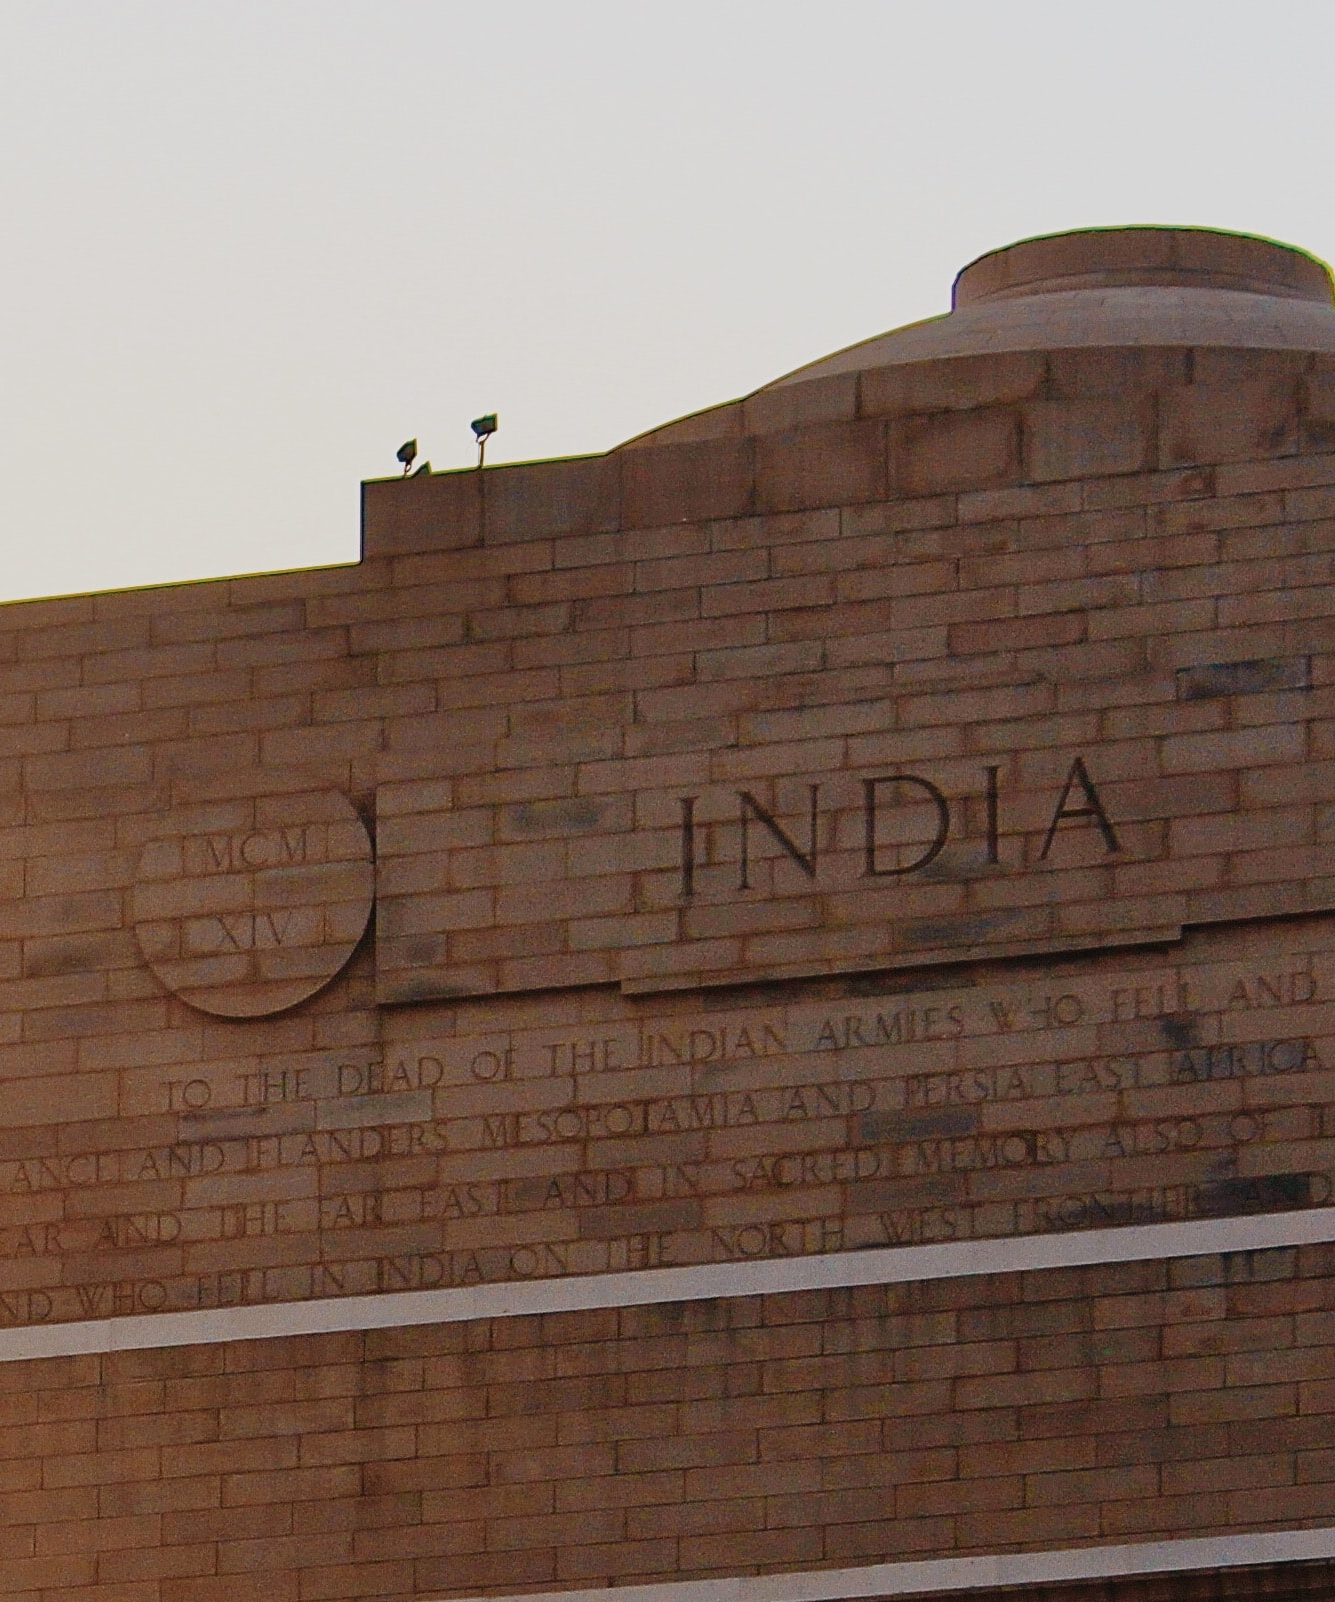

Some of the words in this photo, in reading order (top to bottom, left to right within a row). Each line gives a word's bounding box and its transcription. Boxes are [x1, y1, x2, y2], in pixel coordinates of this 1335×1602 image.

[678, 757, 1119, 896] INDIA
[215, 911, 293, 950] XIV
[168, 1078, 211, 1111] TO
[238, 1067, 308, 1105] THE
[338, 1056, 444, 1094] DEAD
[471, 1045, 515, 1080] OF
[545, 1038, 620, 1078] THE
[646, 1022, 786, 1066] INDIAN
[815, 1004, 963, 1049] ARMIES
[990, 994, 1083, 1032] WHO
[1111, 982, 1190, 1020] FELL
[1227, 970, 1318, 1009] AND
[139, 1143, 224, 1181] AND
[253, 1122, 448, 1173] FLANDERS
[482, 1093, 760, 1148] MESOPOTAMIA
[784, 1081, 877, 1118] AND
[904, 1067, 1029, 1108] PERSIA
[1054, 1054, 1152, 1095] EAST
[1172, 1039, 1321, 1084] AFRICA
[96, 1212, 181, 1250] AND
[220, 1202, 296, 1238] THE
[318, 1193, 383, 1229] FAR
[420, 1180, 511, 1219] EAST
[543, 1167, 632, 1206] AND
[662, 1163, 699, 1196] IN
[734, 1147, 882, 1189] SACRED
[915, 1129, 1076, 1172] MEMORY
[1102, 1118, 1202, 1157] ALSO
[1230, 1113, 1274, 1144] OF
[76, 1277, 167, 1316] WHO
[196, 1268, 278, 1304] FELL
[309, 1261, 346, 1295] IN
[377, 1251, 484, 1291] INDIA
[509, 1242, 565, 1278] ON
[607, 1229, 672, 1270] THE
[711, 1219, 844, 1259] NORTH
[879, 1200, 983, 1245] WEST
